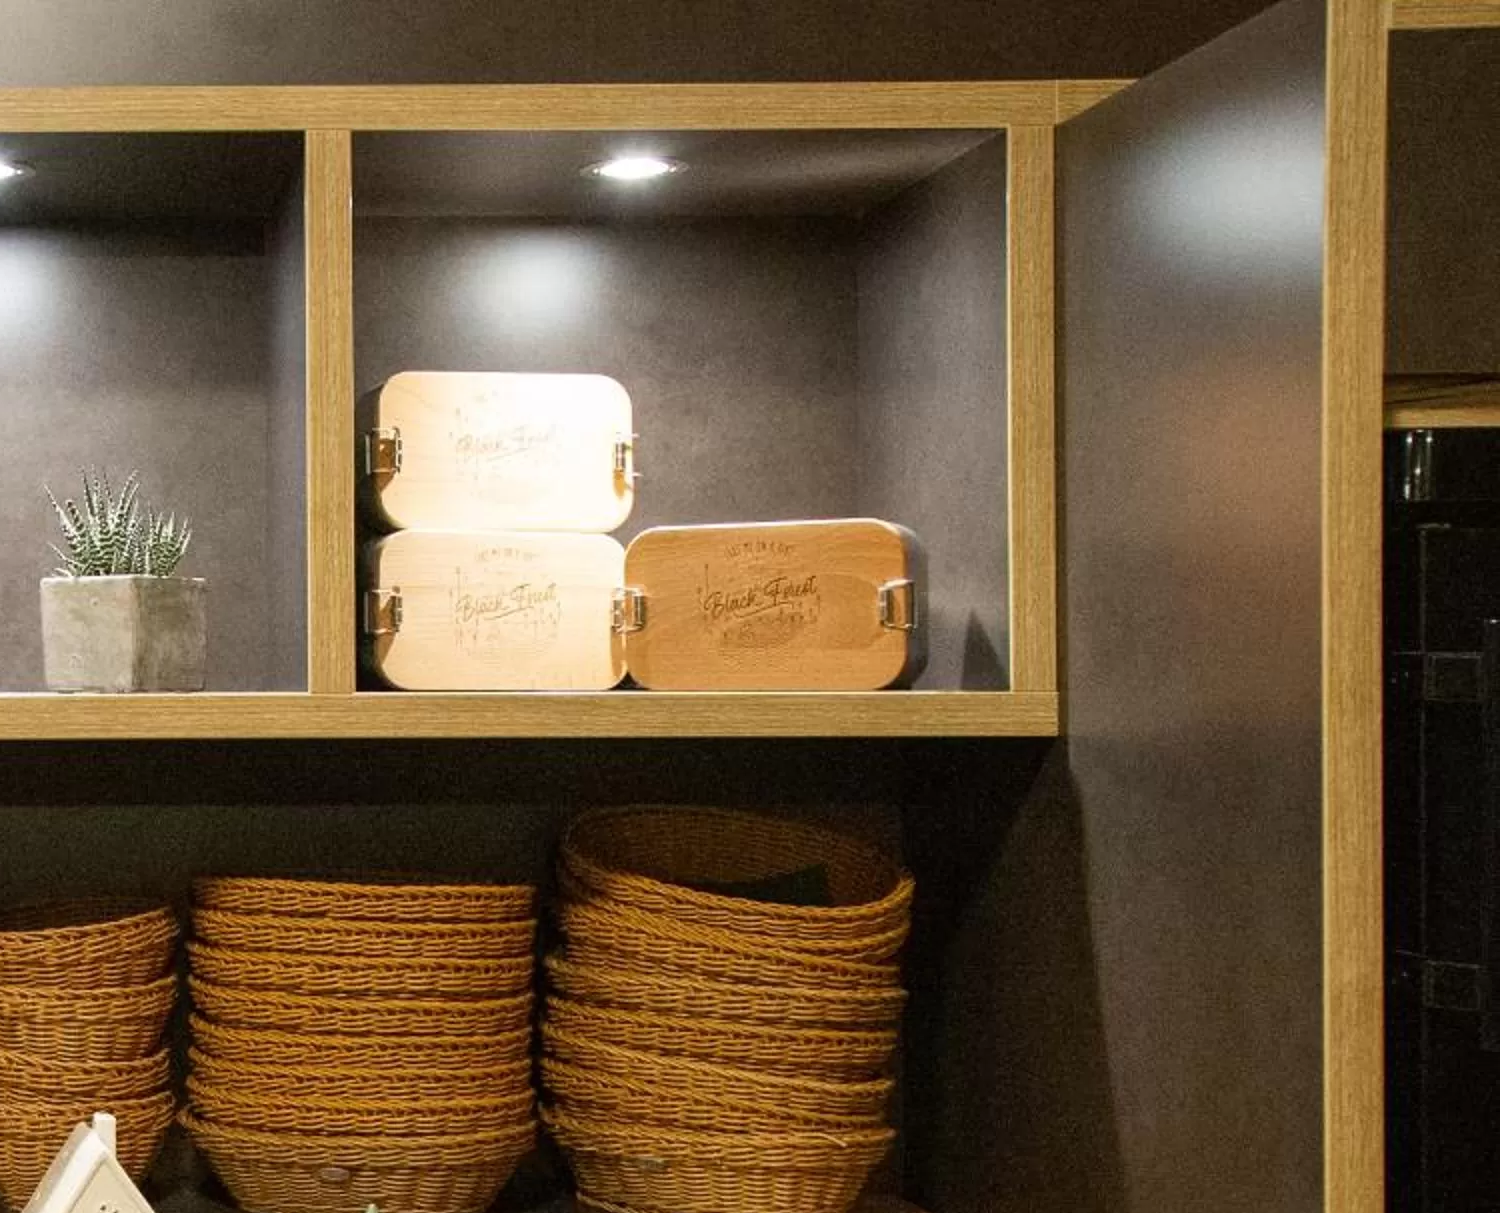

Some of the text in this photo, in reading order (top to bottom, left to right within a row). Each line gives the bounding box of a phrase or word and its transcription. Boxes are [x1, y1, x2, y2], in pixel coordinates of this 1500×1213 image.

[455, 593, 503, 622] Black
[703, 575, 818, 619] Black Forest
